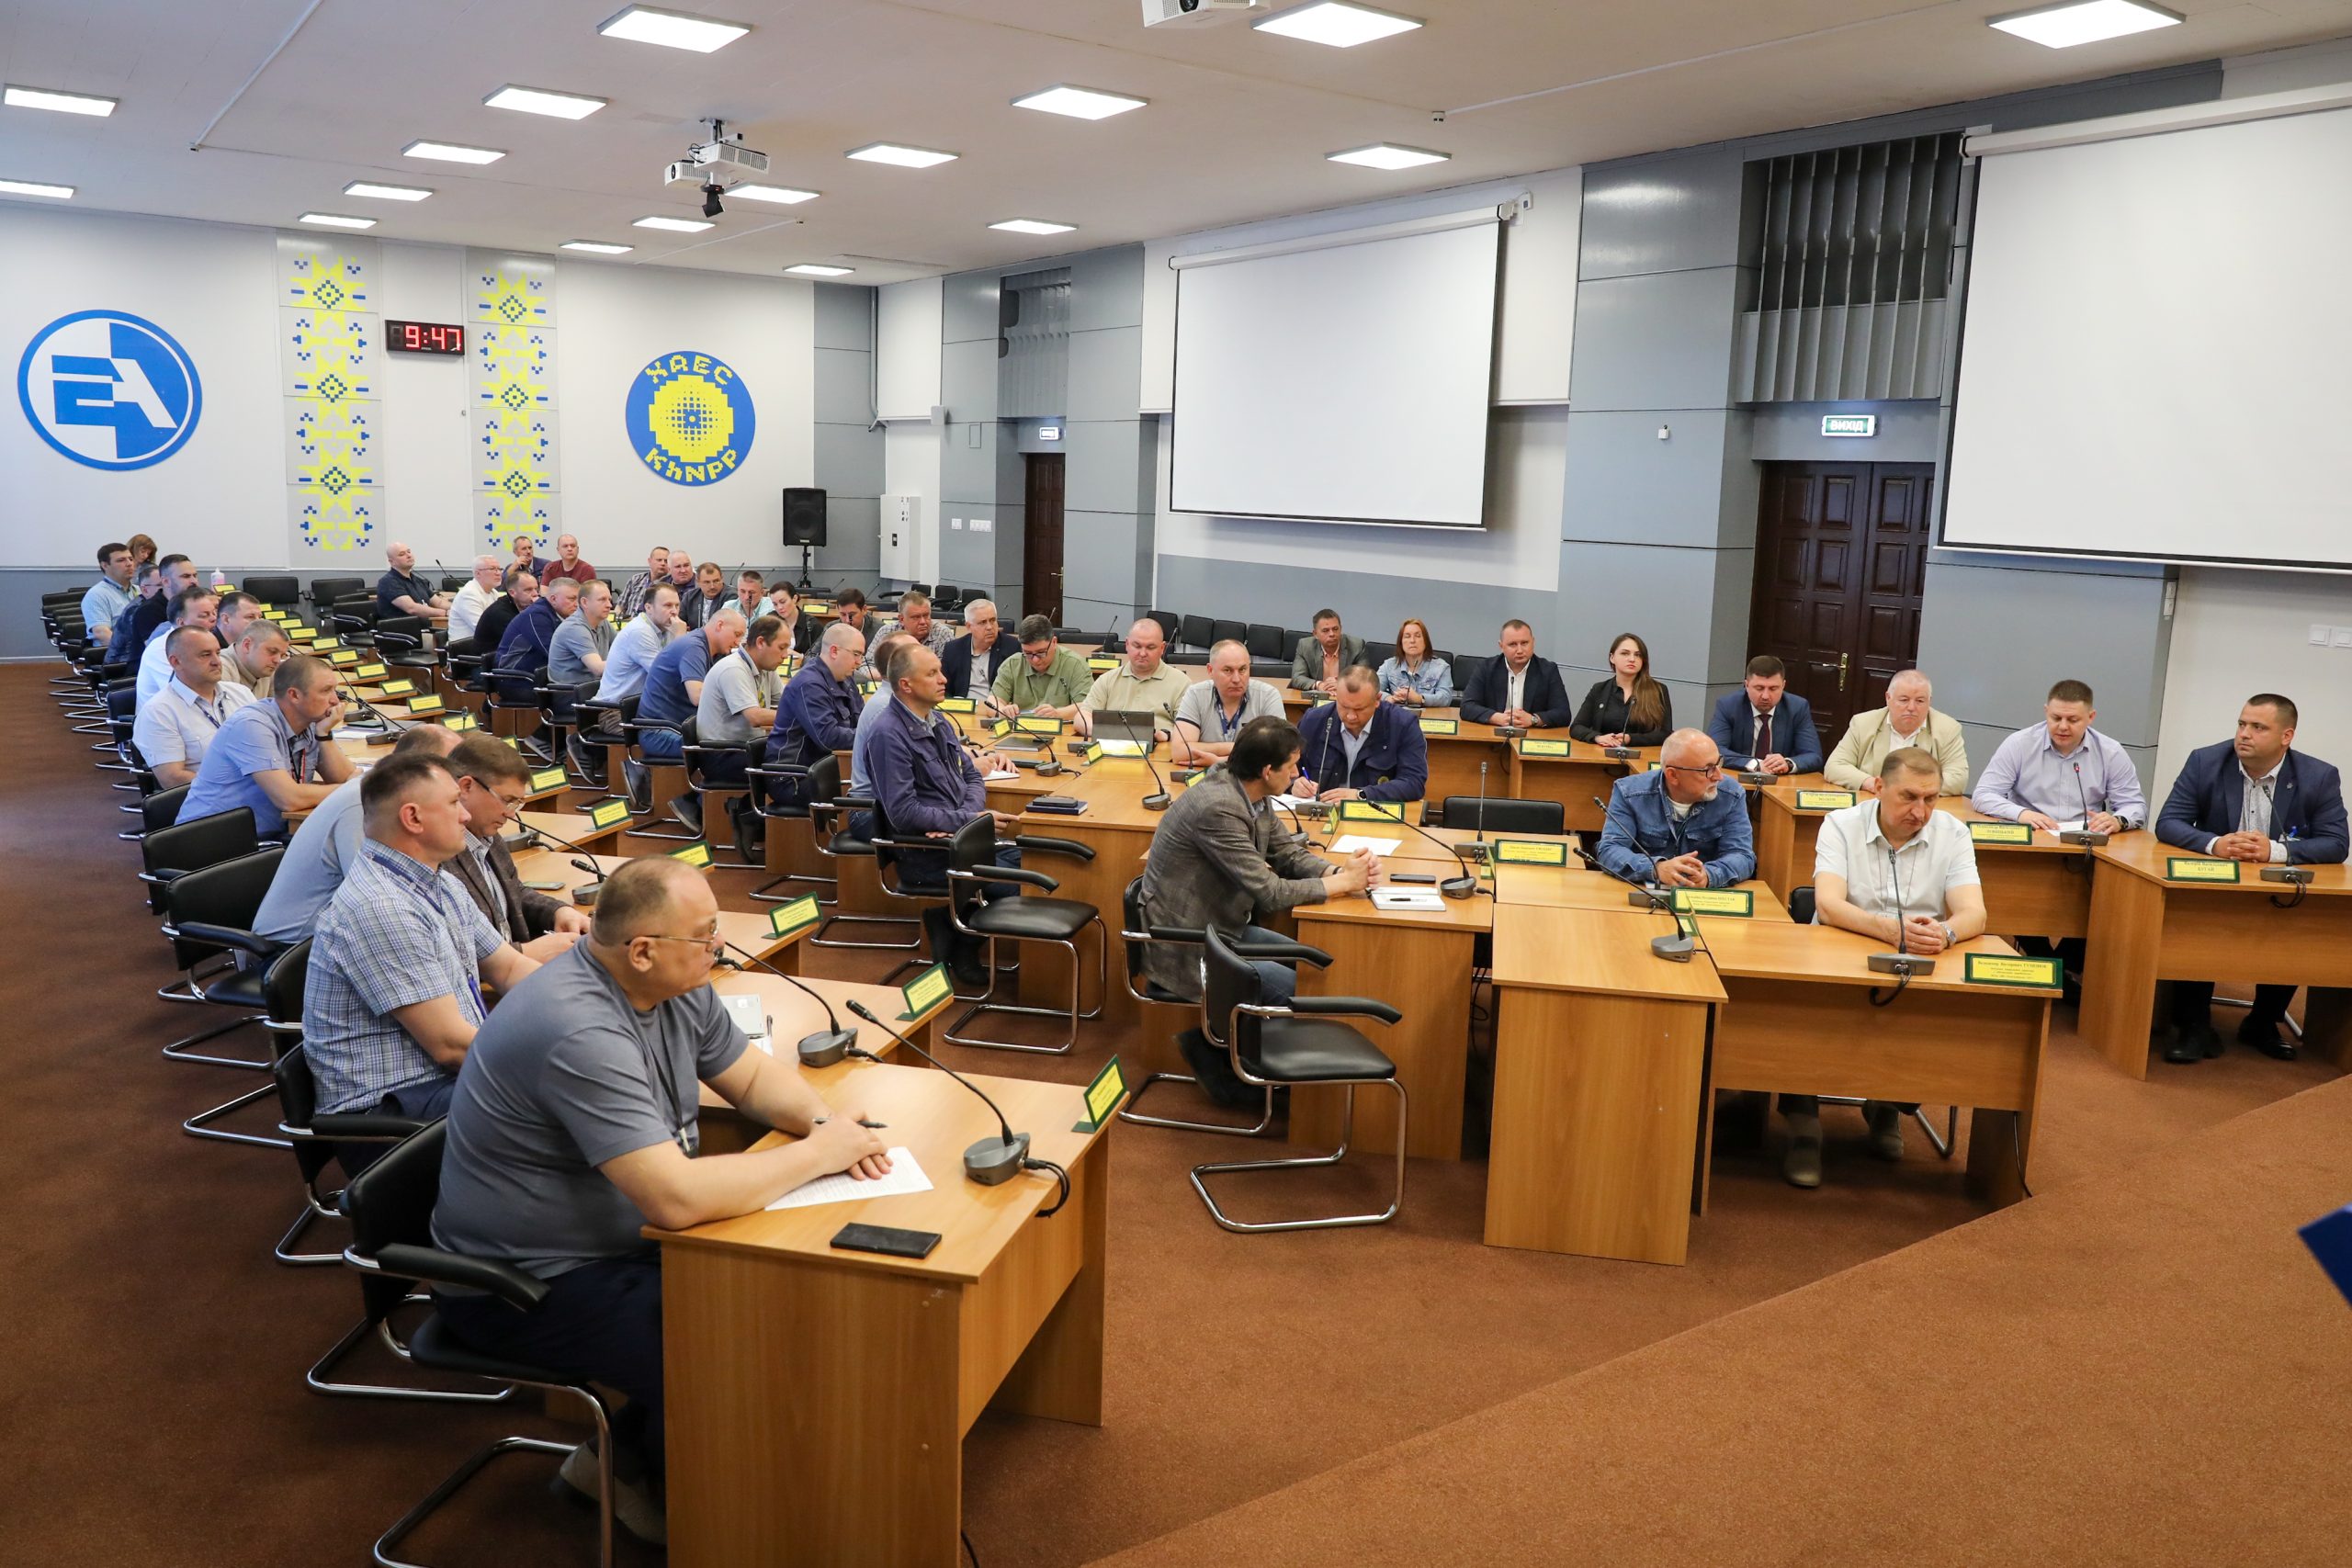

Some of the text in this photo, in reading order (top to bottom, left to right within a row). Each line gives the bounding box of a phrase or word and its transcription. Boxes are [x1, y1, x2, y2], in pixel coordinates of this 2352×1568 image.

[405, 325, 461, 351] 9:47
[645, 355, 733, 385] ХАЕС
[1830, 421, 1864, 433] ВИХІД
